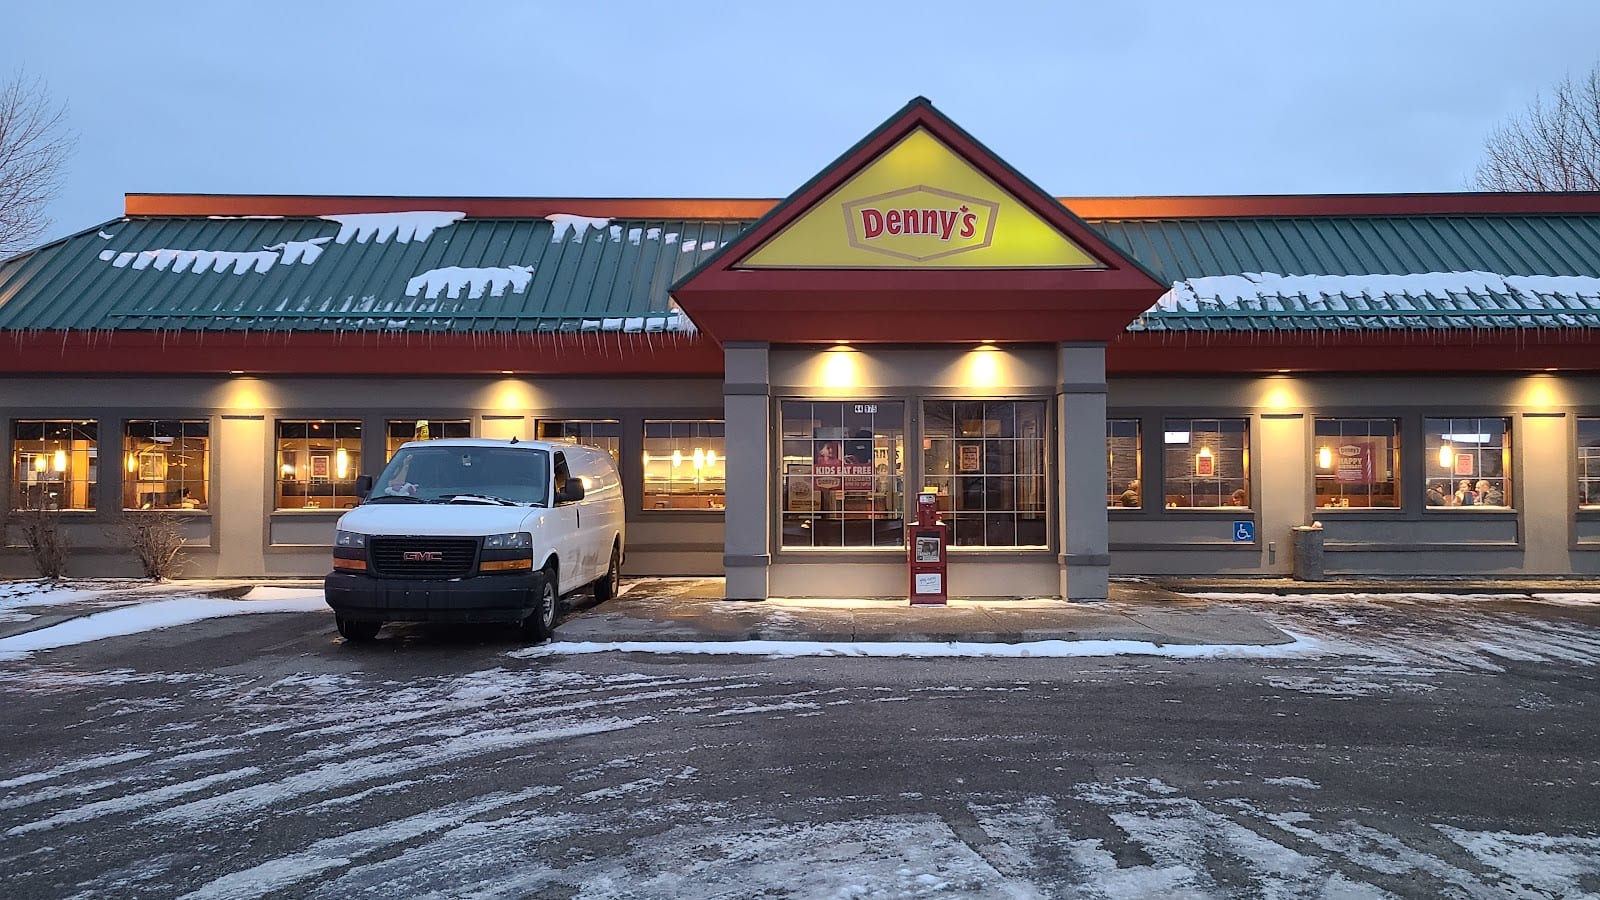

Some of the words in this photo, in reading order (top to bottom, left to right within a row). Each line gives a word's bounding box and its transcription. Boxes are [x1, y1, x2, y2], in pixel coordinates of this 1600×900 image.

[860, 205, 978, 241] Denny's
[816, 466, 835, 474] KIDS
[836, 466, 851, 474] EAT
[852, 466, 871, 474] FREE
[404, 551, 442, 561] GMC
